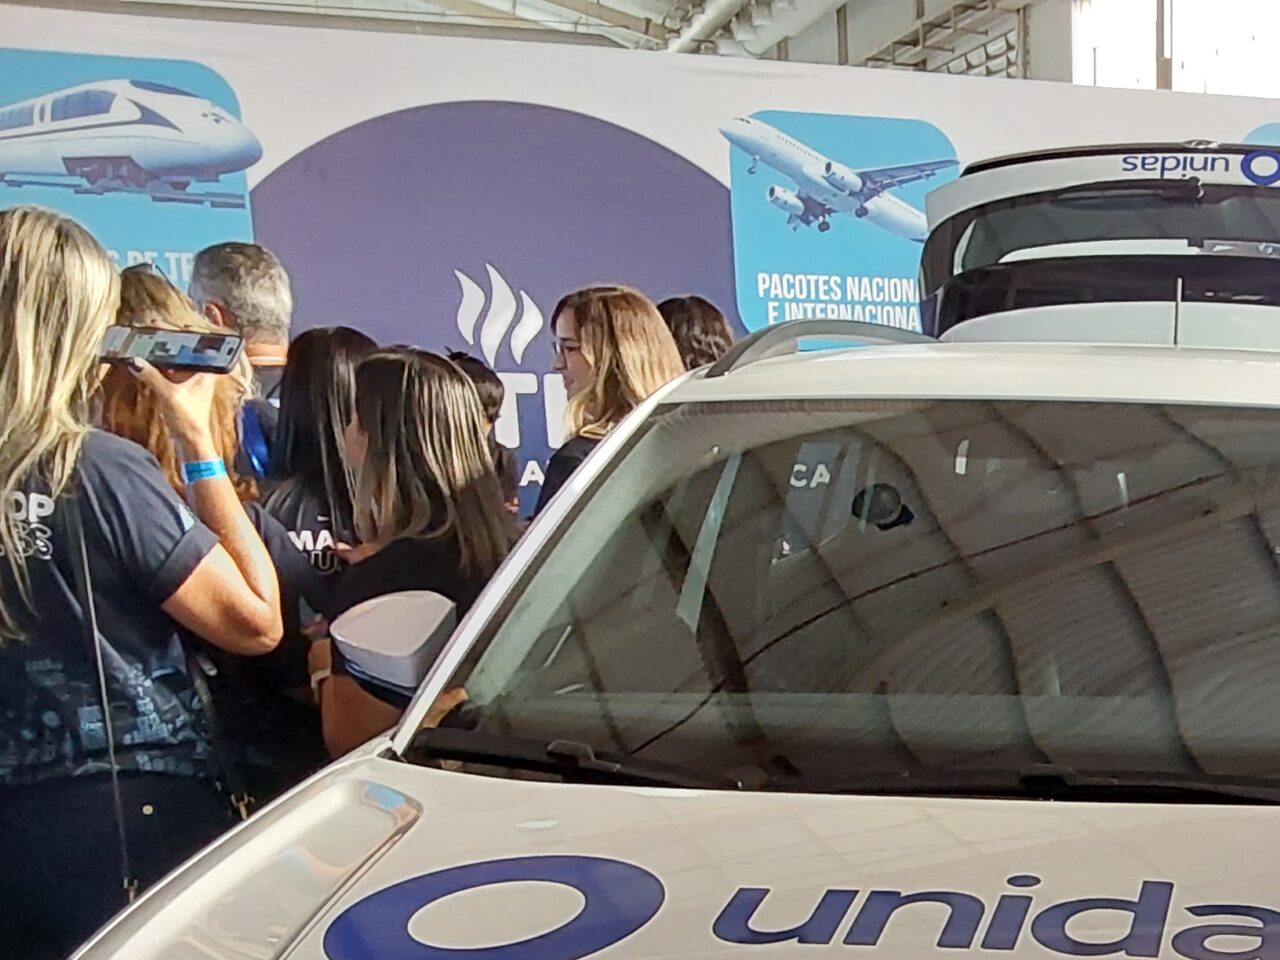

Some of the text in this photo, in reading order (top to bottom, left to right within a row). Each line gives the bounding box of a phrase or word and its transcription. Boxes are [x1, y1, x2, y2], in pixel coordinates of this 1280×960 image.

[1122, 155, 1230, 179] unidas
[757, 272, 842, 299] PACOTES
[767, 302, 779, 325] E
